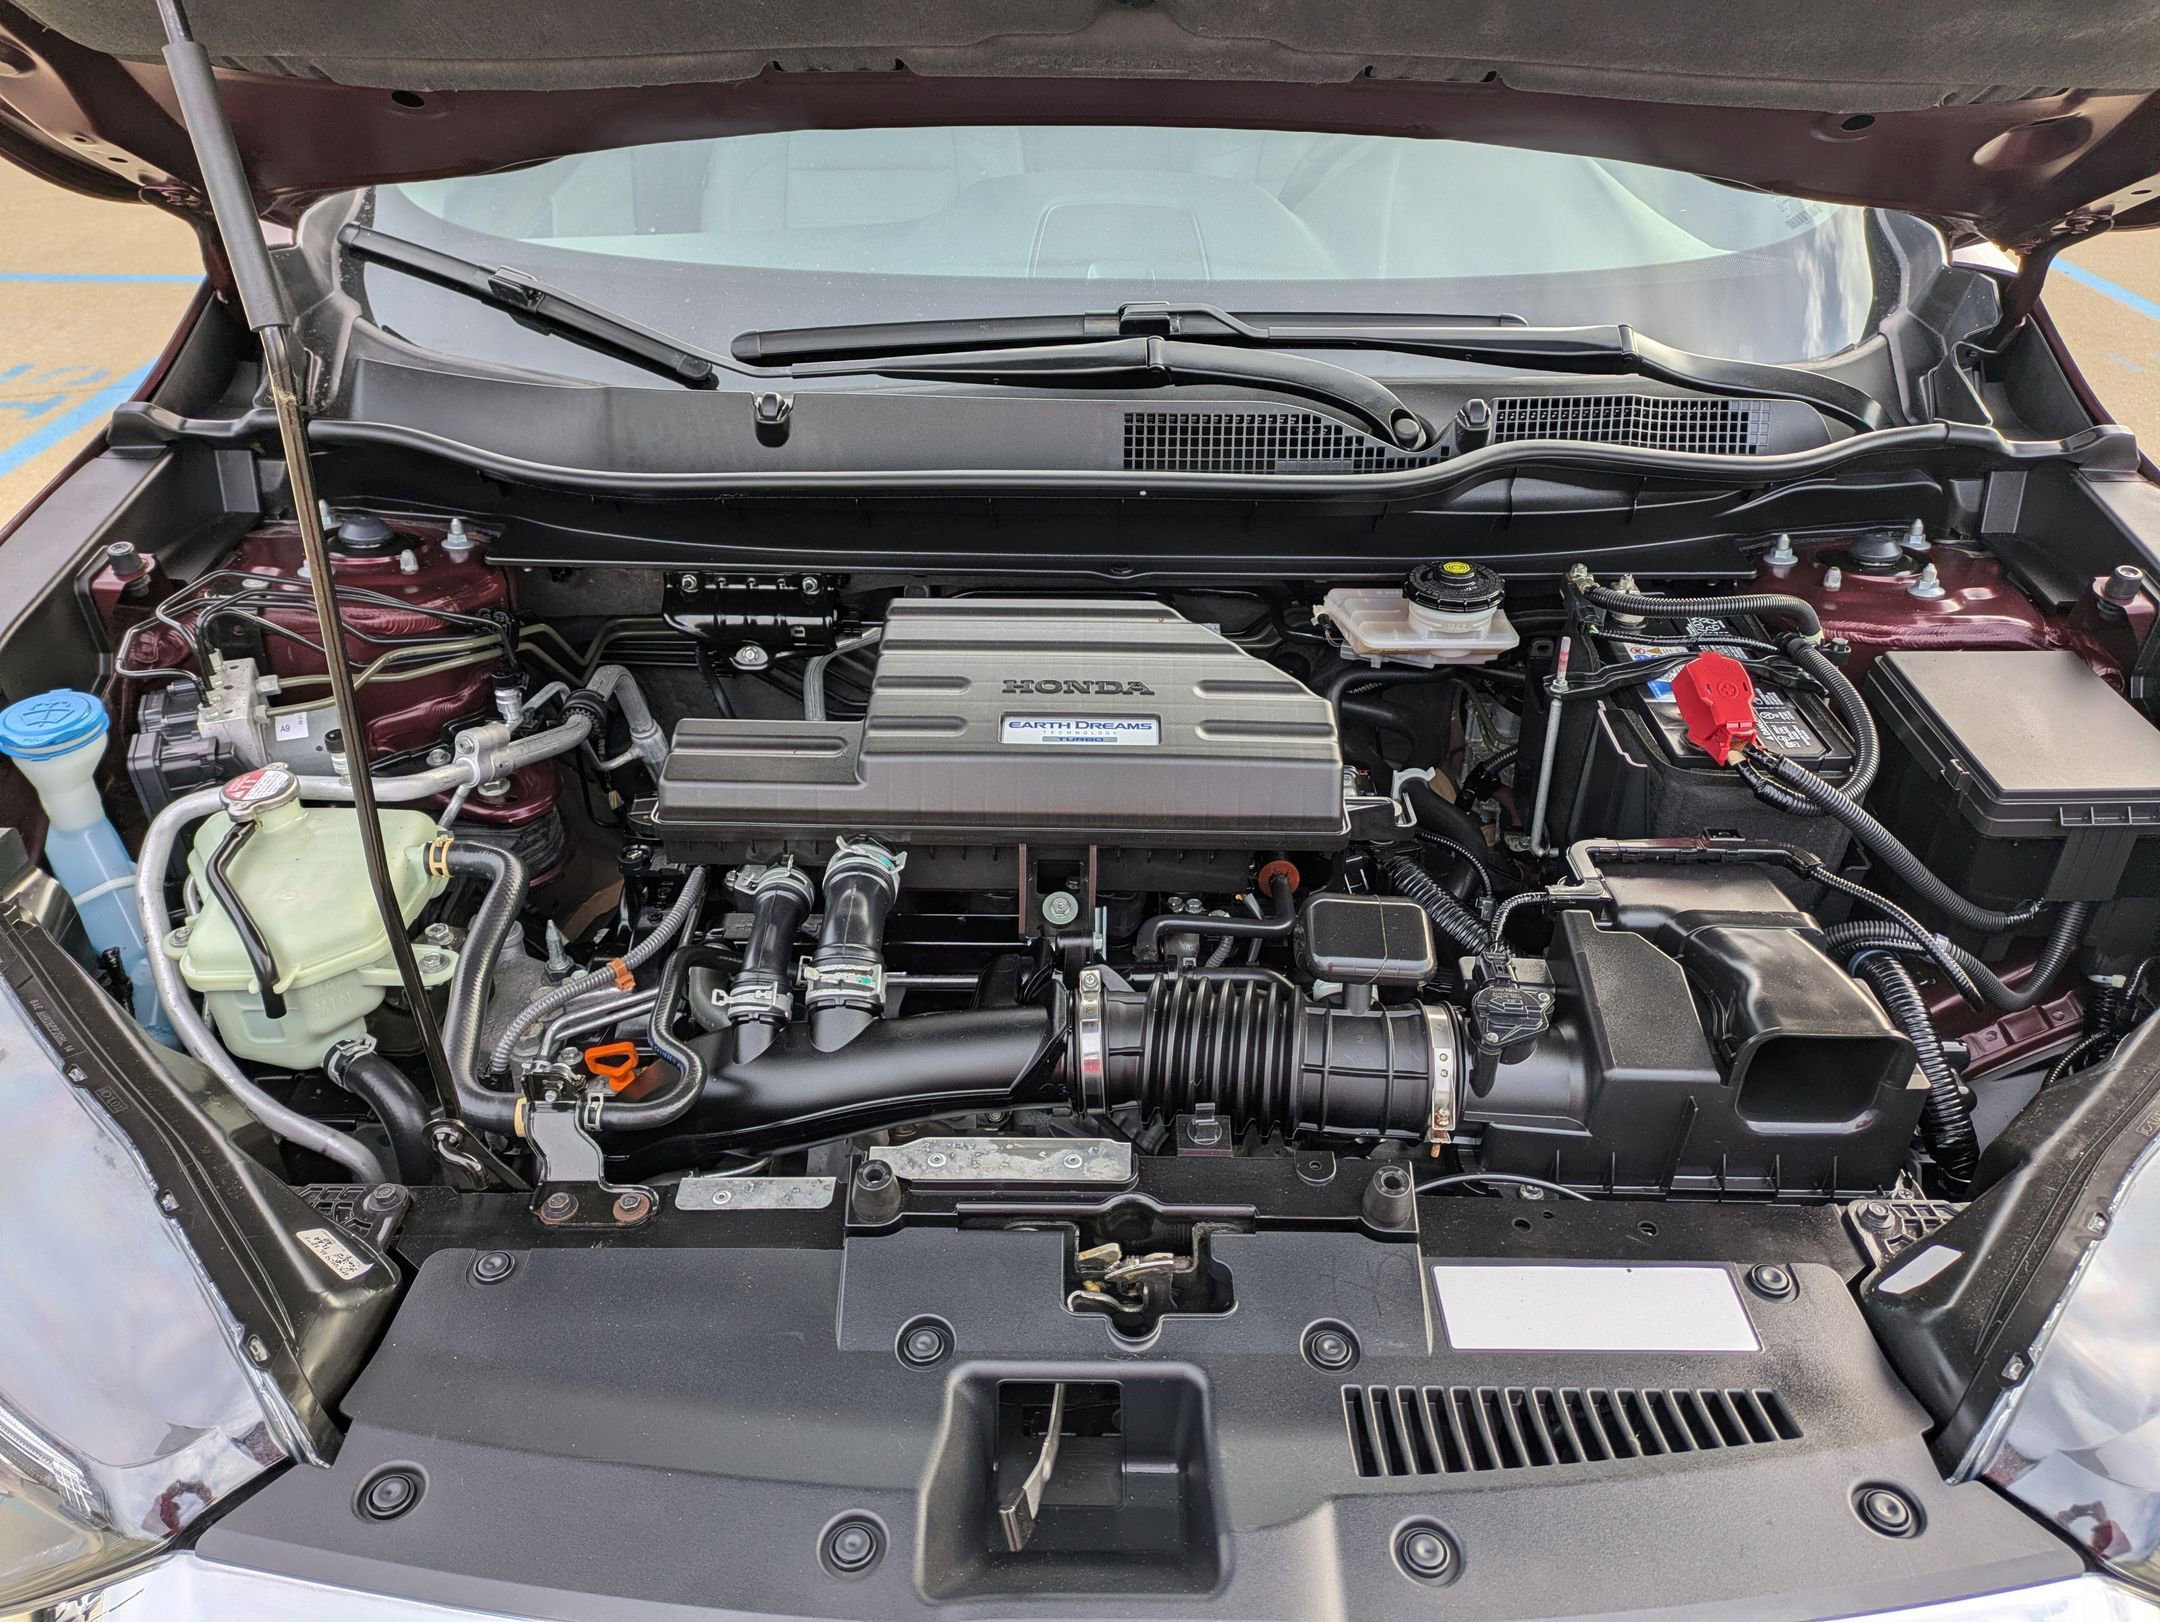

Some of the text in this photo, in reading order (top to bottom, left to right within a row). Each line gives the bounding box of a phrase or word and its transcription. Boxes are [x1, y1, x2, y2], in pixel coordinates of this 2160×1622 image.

[1002, 679, 1156, 696] HONDA
[280, 724, 291, 732] A9
[1008, 720, 1153, 731] EARTH DREAMS
